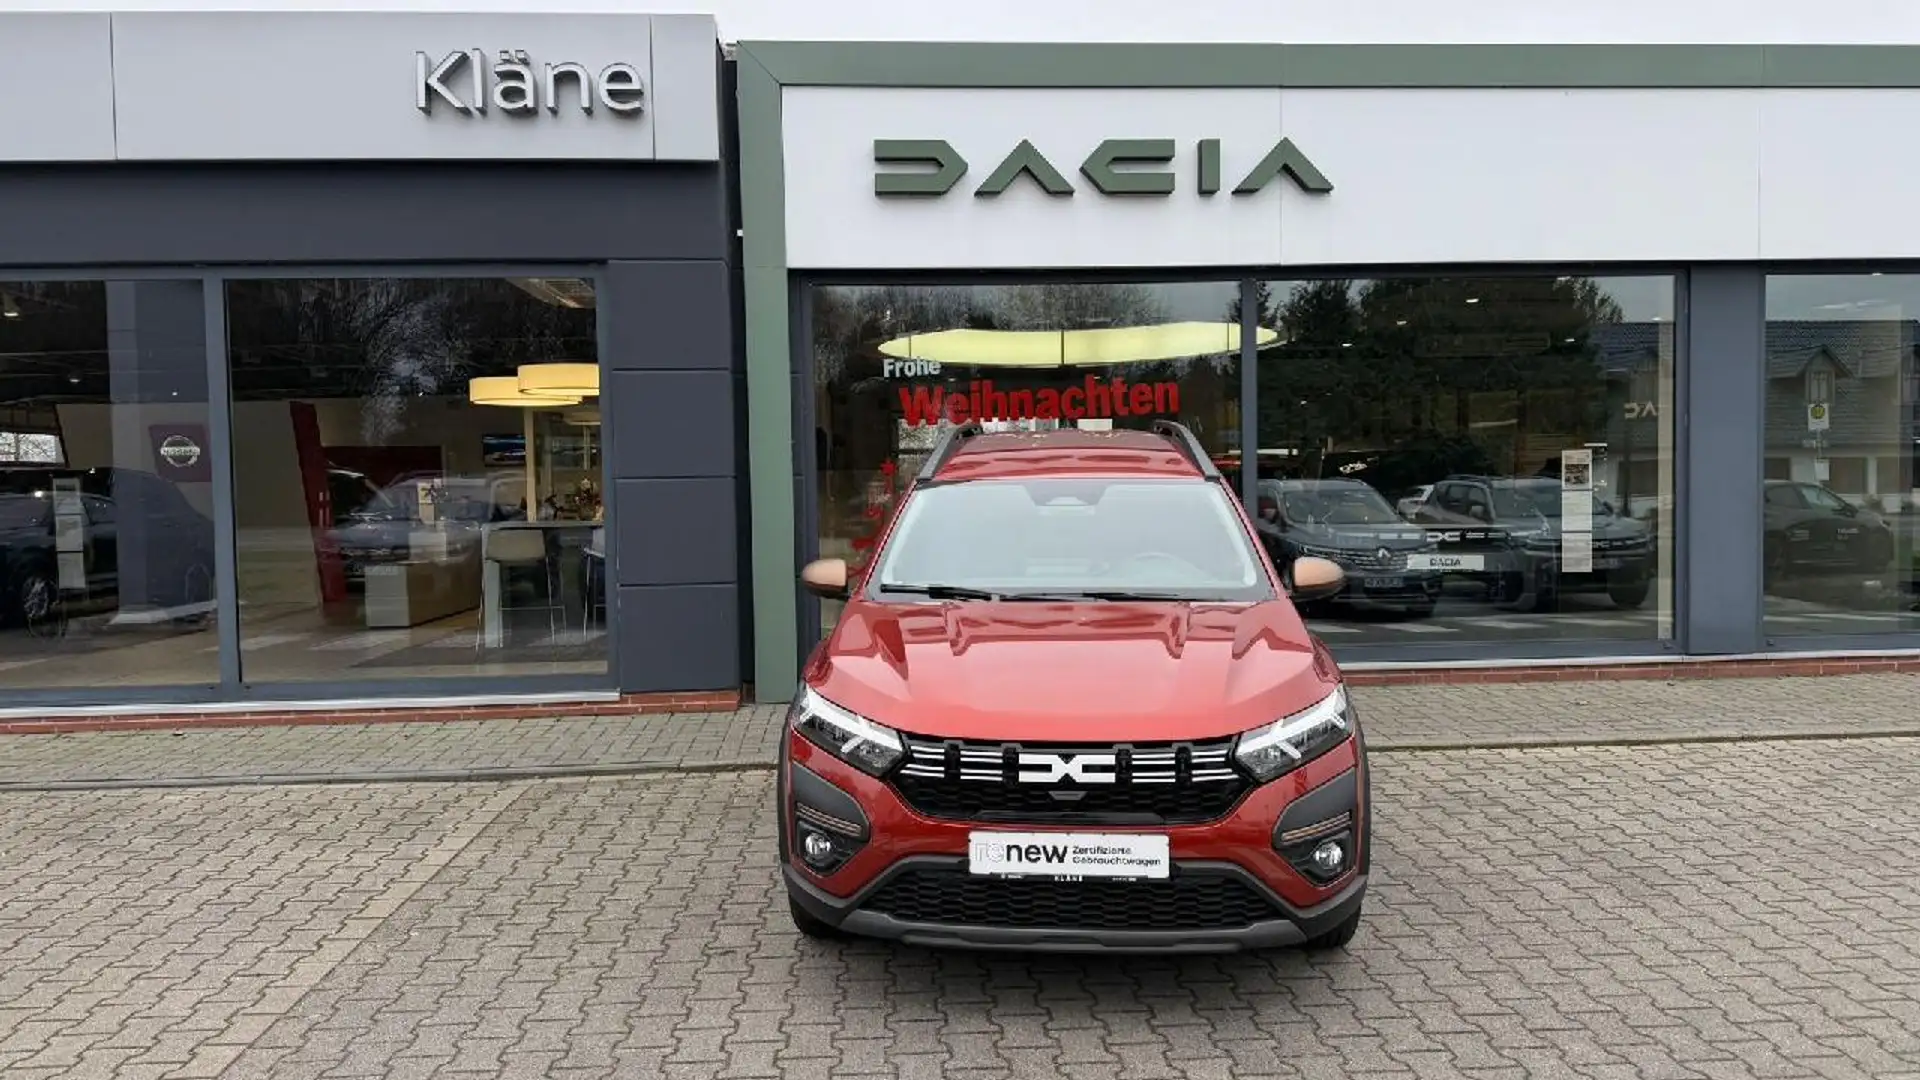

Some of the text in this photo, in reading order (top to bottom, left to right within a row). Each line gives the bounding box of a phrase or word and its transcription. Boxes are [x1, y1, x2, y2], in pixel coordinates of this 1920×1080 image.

[416, 48, 645, 115] Kläne
[874, 137, 1334, 195] DACIA
[883, 356, 942, 378] Frohe
[899, 373, 1180, 427] Weihnachten
[975, 843, 1068, 864] renew
[1072, 845, 1132, 856] Zertifizierte
[1072, 856, 1161, 867] Gebrauchtwagen
